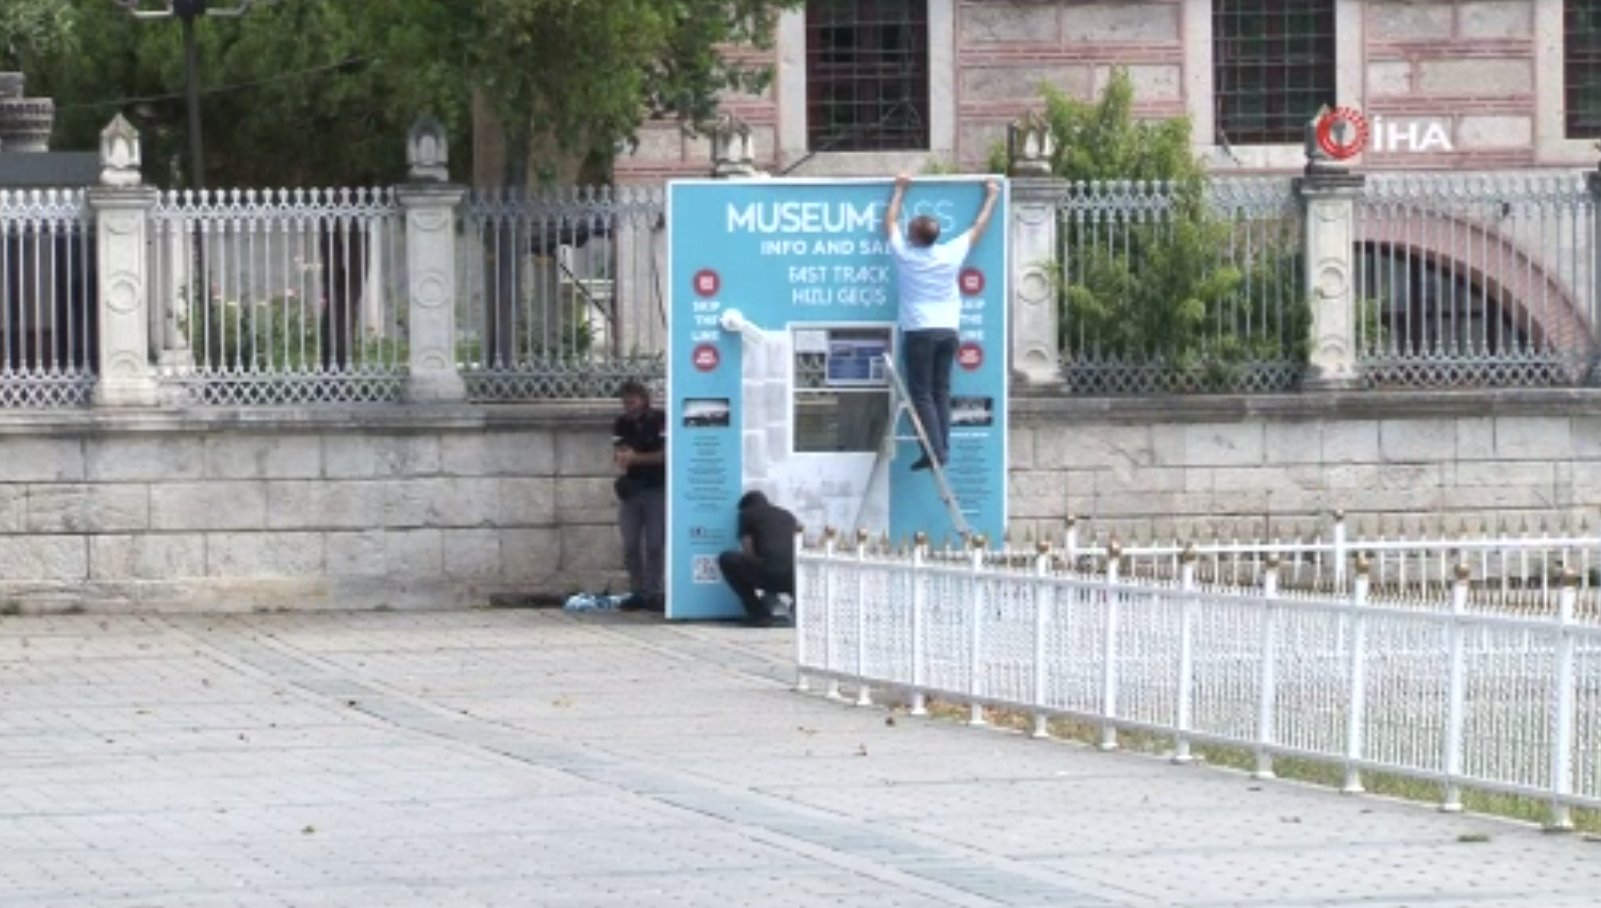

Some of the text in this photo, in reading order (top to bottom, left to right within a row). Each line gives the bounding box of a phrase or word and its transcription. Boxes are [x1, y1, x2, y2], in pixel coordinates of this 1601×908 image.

[761, 239, 893, 255] INFO AND SAL
[788, 265, 890, 283] FAST TRACK
